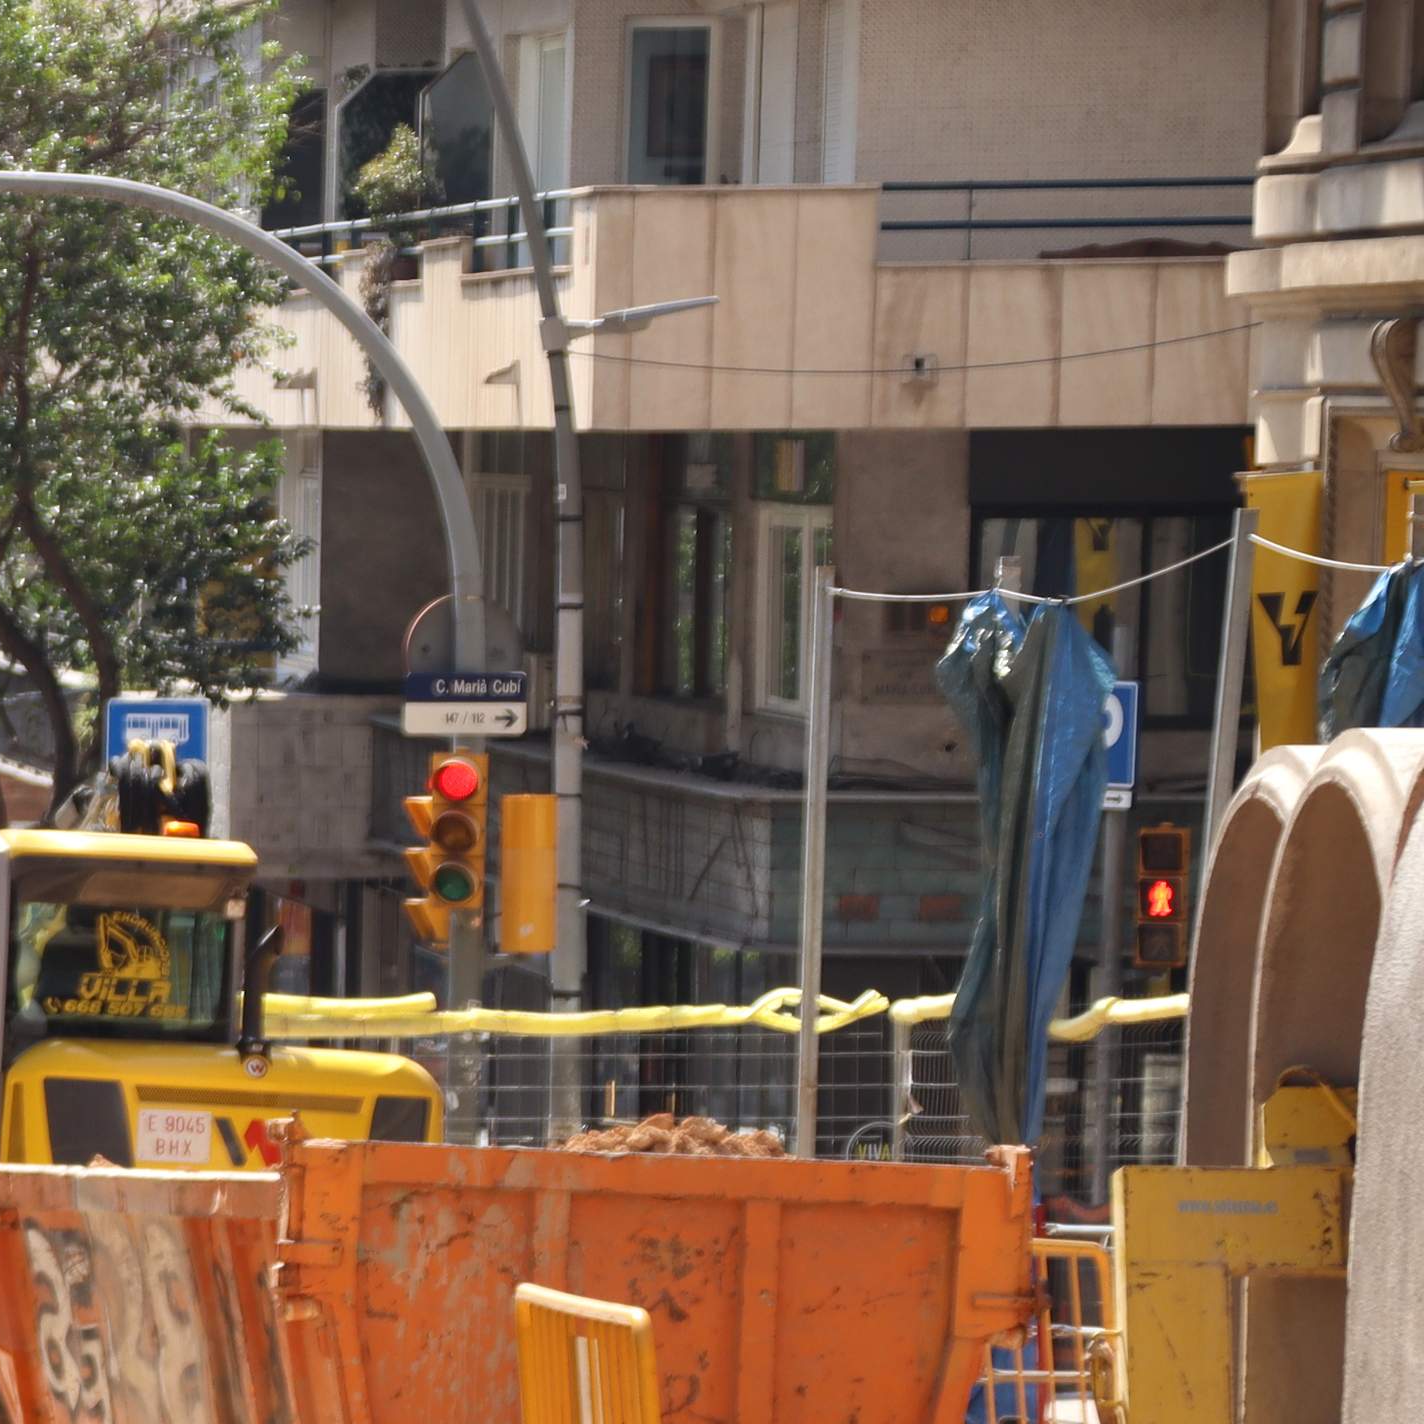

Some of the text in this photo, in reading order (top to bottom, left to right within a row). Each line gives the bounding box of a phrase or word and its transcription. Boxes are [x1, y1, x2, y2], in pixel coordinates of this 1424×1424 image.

[436, 679, 521, 694] C. Marià Cubí
[445, 712, 460, 724] 147
[472, 712, 486, 724] 112
[148, 1114, 157, 1132] E
[155, 1137, 192, 1156] BHX
